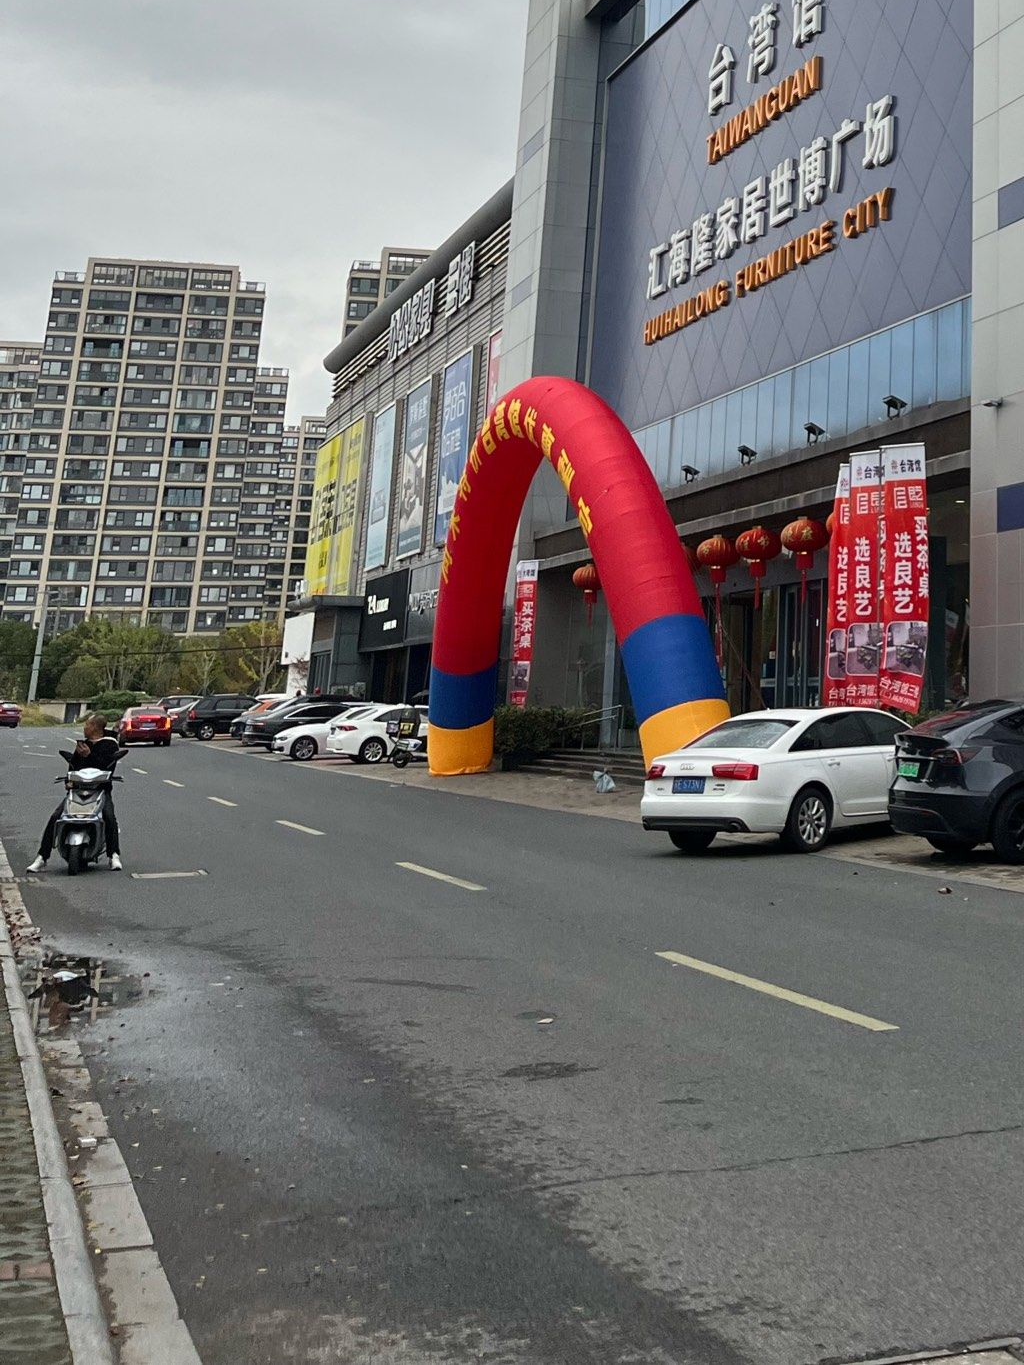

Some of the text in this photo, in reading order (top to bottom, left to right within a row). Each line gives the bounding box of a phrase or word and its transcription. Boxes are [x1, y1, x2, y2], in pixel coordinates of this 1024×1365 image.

[706, 55, 823, 165] TAIWANGUAN
[646, 94, 897, 300] 汇海隆家居世博广场
[642, 187, 897, 346] HUIHAILONG FURNITURE CITY
[853, 536, 873, 617] 选良艺
[893, 531, 914, 614] 选良艺
[914, 516, 930, 599] 买茶桌
[520, 601, 534, 649] 买茶桌
